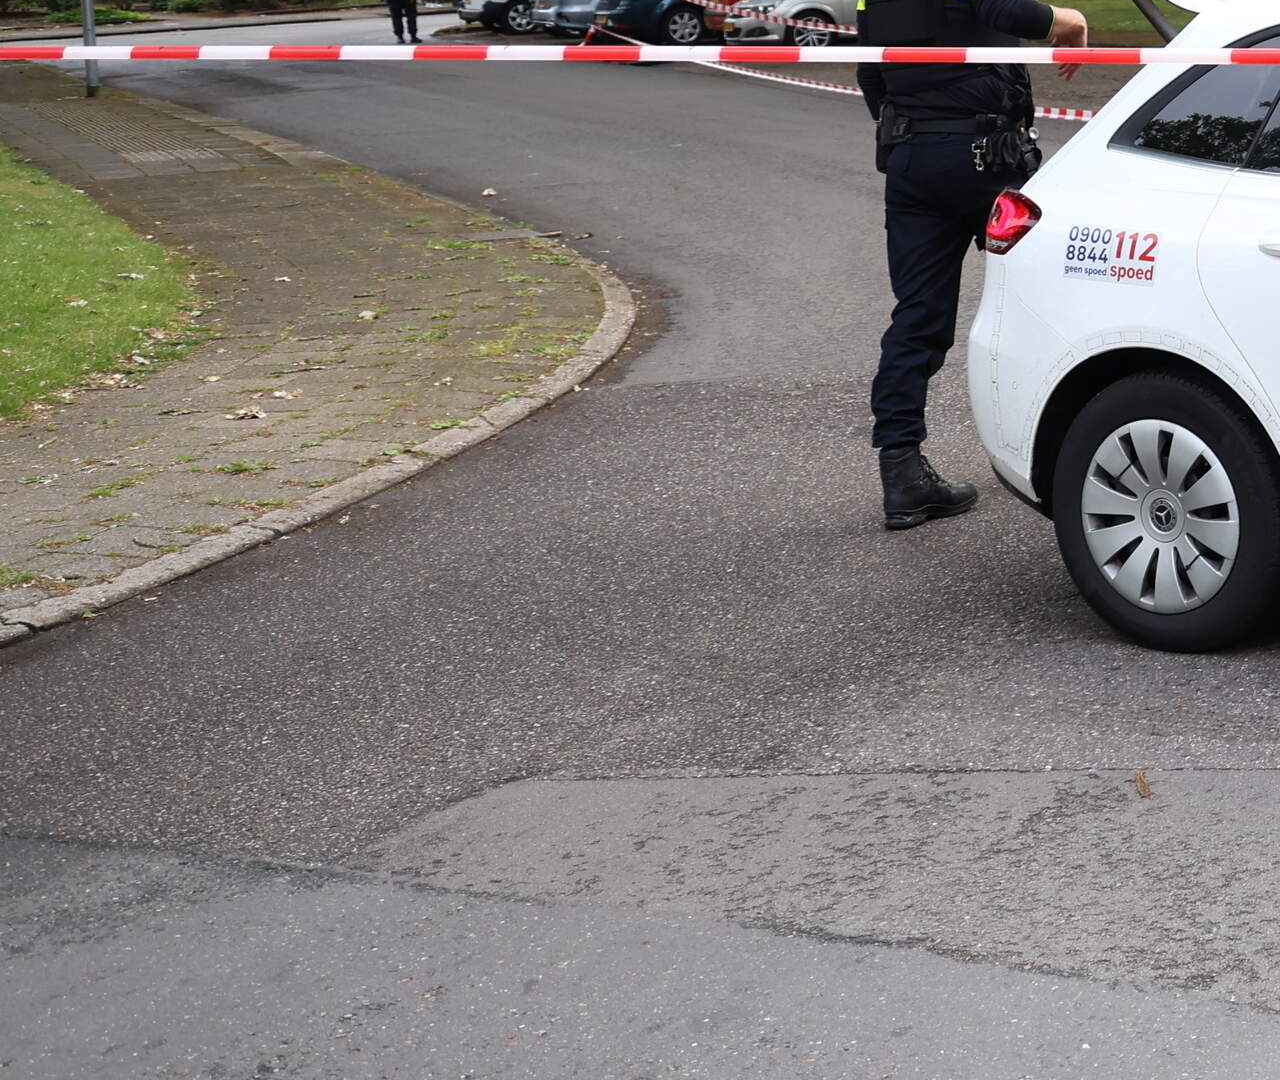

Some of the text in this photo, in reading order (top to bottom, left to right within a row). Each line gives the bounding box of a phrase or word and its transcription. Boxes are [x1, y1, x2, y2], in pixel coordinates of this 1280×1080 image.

[1069, 226, 1159, 262] 0900 112
[1066, 244, 1108, 264] 8844
[1064, 265, 1107, 276] geen spoed
[1110, 265, 1154, 282] spoed
